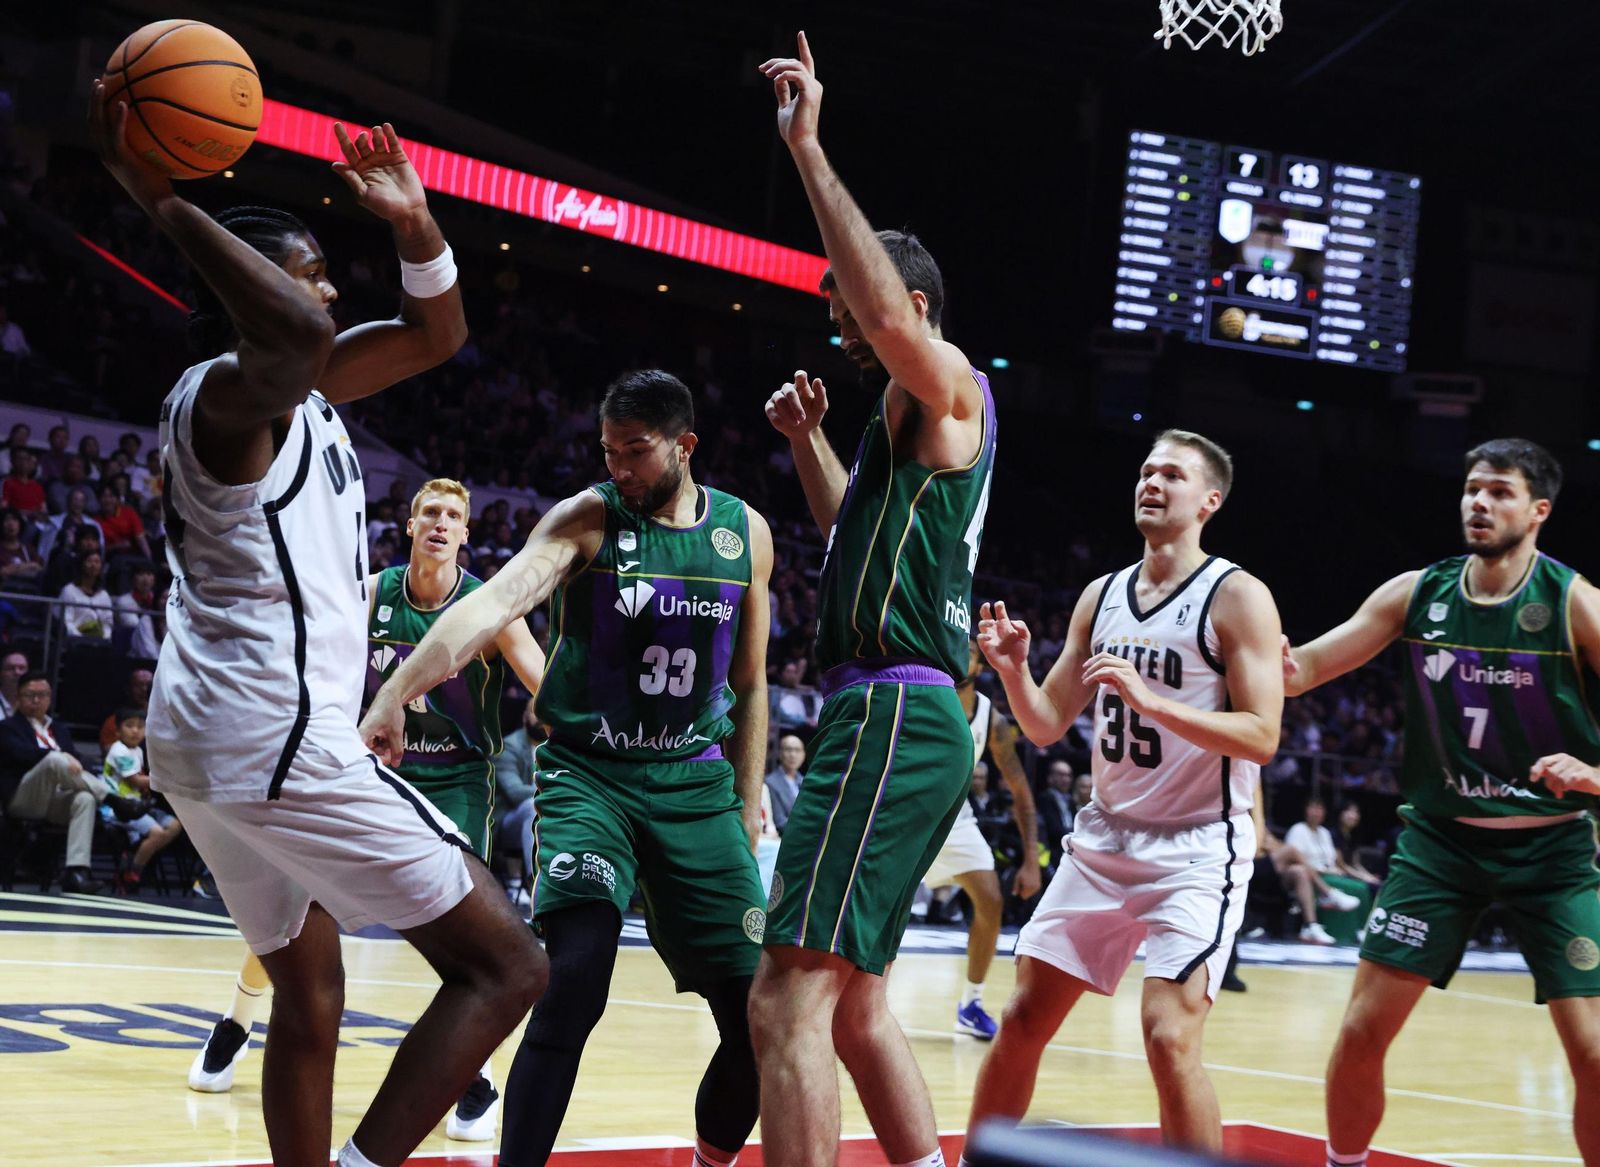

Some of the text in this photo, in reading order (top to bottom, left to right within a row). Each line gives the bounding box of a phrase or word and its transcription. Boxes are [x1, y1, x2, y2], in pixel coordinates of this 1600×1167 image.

[1239, 153, 1257, 177] 7
[1289, 163, 1319, 189] 13
[660, 594, 734, 624] Unicaja
[639, 645, 697, 697] 33
[1459, 663, 1535, 689] Unicaja
[402, 731, 458, 753] dalucía
[1101, 694, 1162, 769] 35
[1463, 707, 1489, 750] 7
[582, 853, 616, 877] COSTA
[582, 863, 617, 886] DEL SOL
[1391, 913, 1429, 933] COSTA
